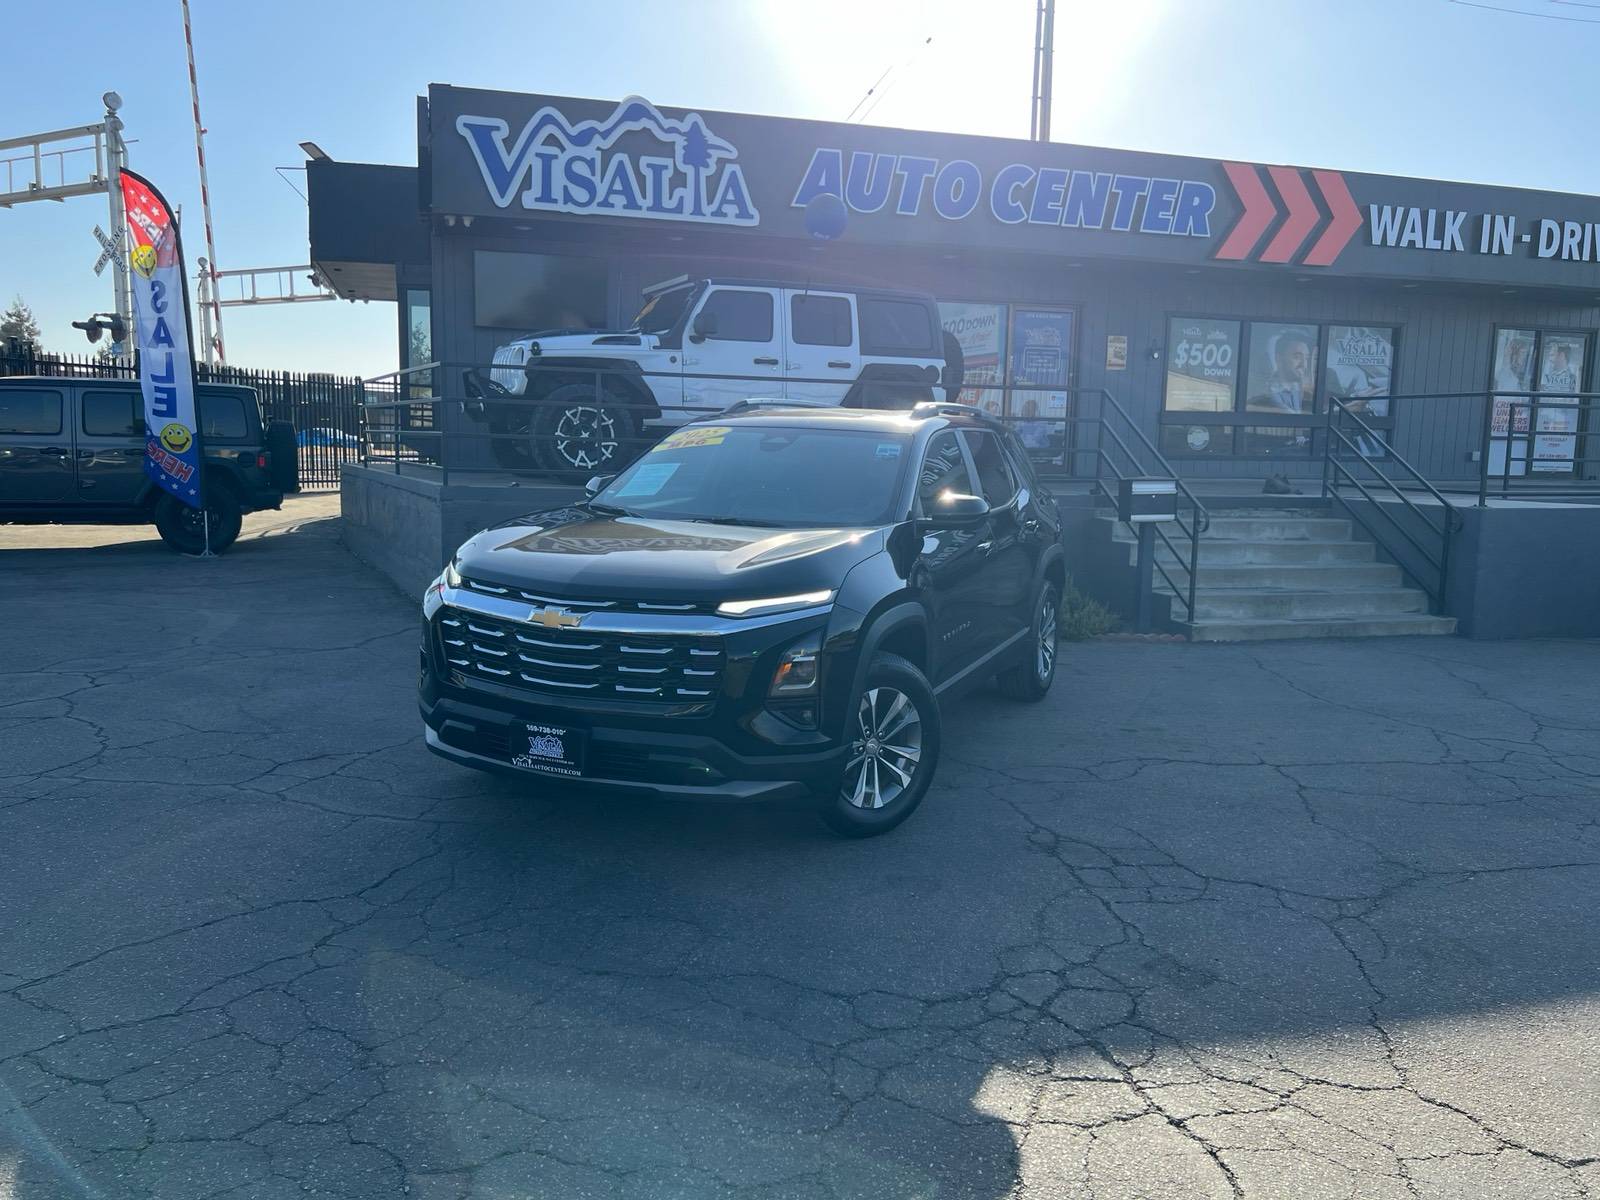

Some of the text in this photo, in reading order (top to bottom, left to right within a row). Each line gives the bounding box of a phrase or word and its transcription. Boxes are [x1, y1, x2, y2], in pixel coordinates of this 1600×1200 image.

[457, 98, 760, 225] VISALIA
[791, 147, 1216, 238] AUTO CENTER
[1369, 203, 1468, 252] WALK
[1479, 213, 1516, 255] IN
[1174, 339, 1232, 369] $500
[1336, 335, 1387, 356] VISALIA
[1204, 367, 1232, 377] DOWN
